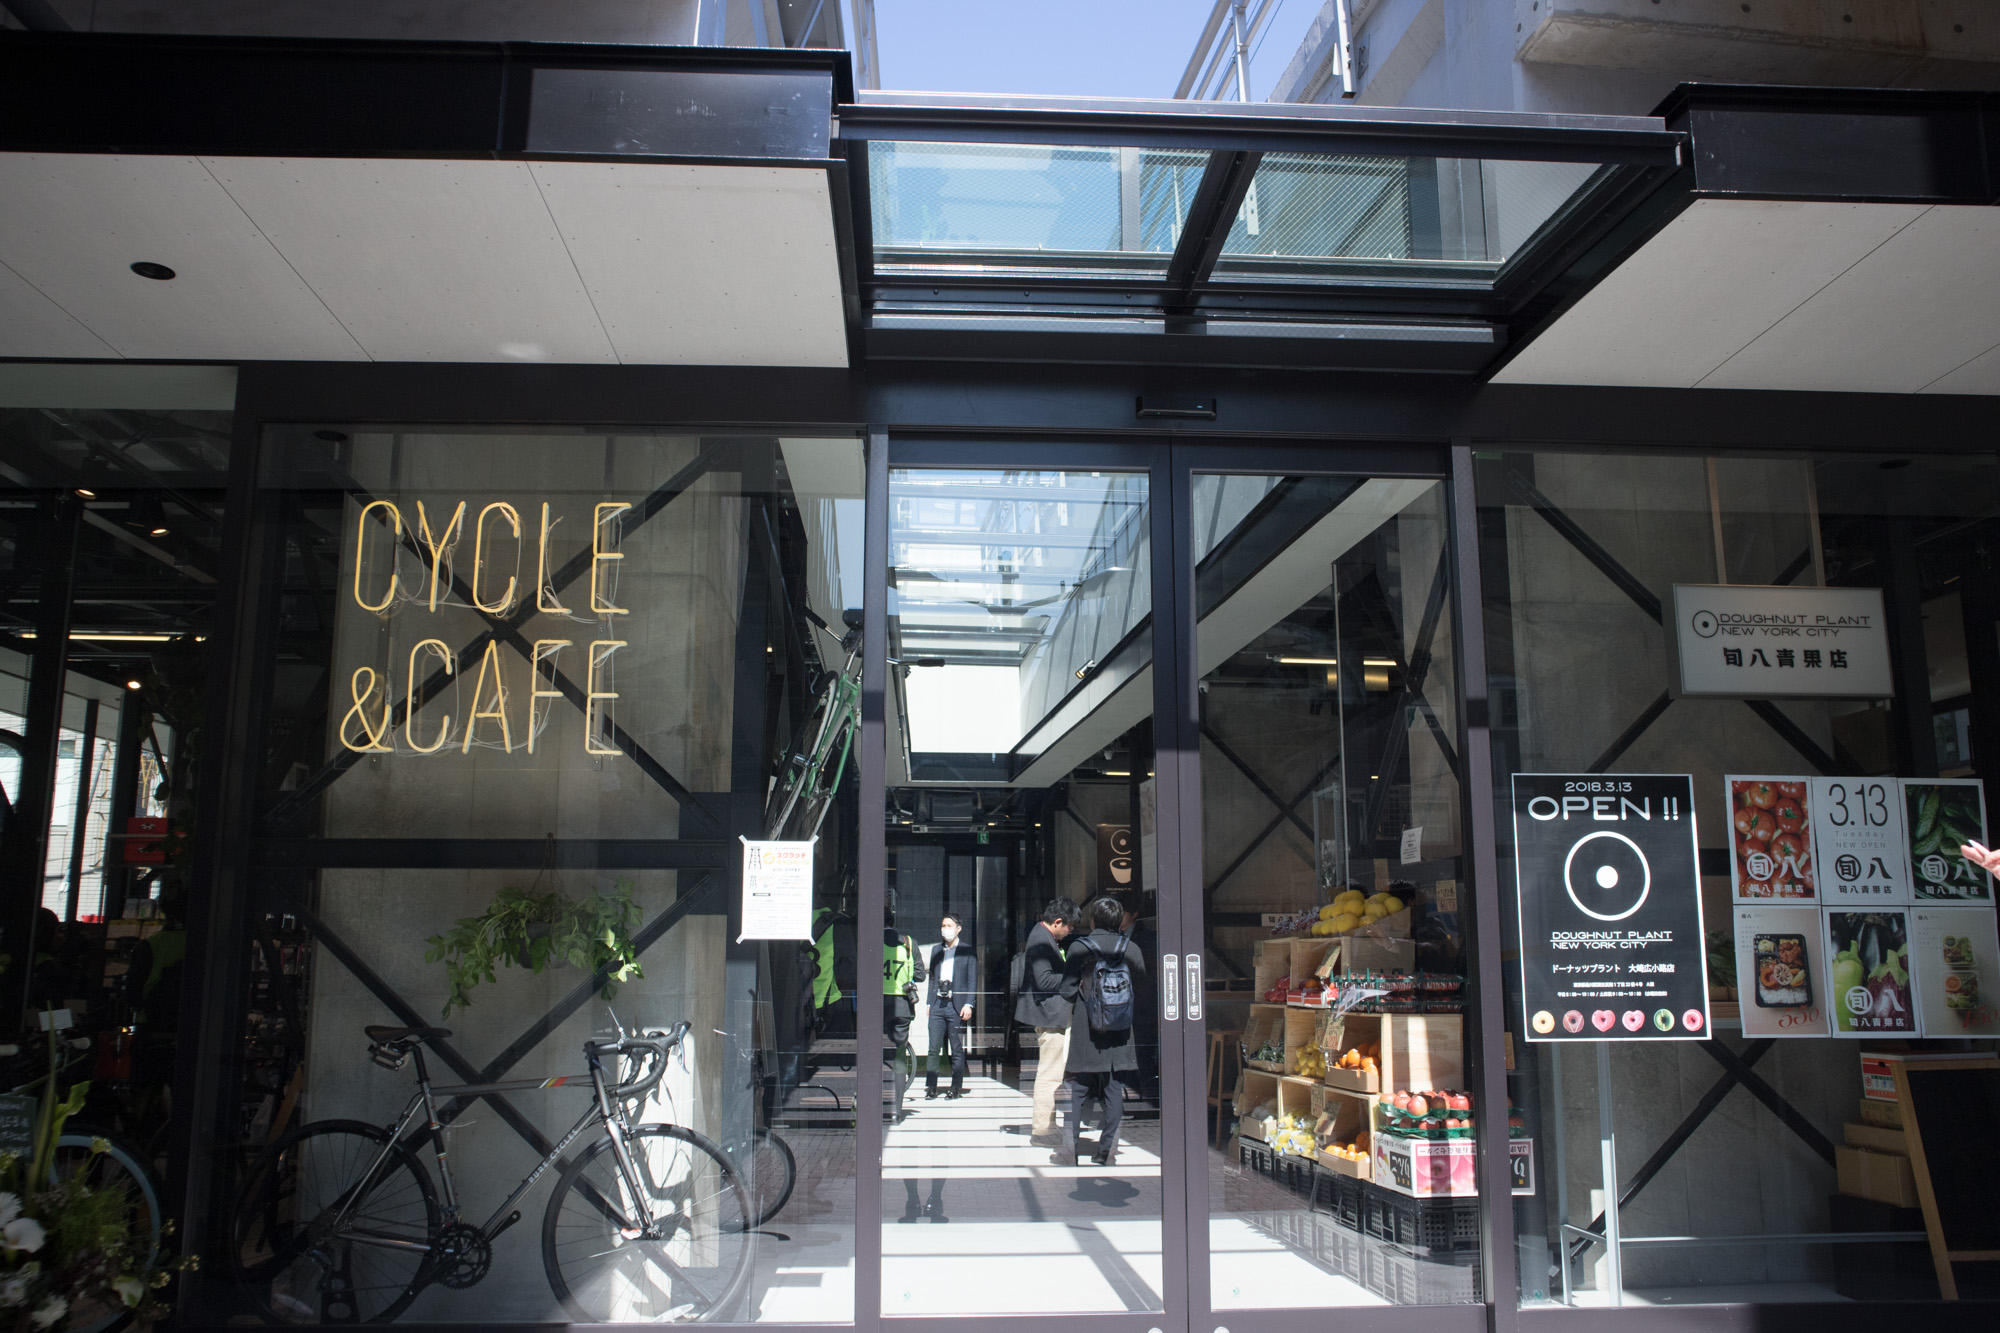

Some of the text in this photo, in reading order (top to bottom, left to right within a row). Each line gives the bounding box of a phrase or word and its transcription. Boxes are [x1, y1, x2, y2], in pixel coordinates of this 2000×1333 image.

[354, 499, 633, 614] CYCLE
[1720, 613, 1871, 626] DOUGHNUT PLANT
[1721, 627, 1840, 637] NEW YORK CITY
[1723, 647, 1848, 669] 旬八青果店
[1565, 781, 1632, 792] 2018.3.13
[1527, 796, 1651, 821] OPEN
[1829, 783, 1888, 827] 3.13
[1747, 853, 1804, 881] 旬八
[1835, 854, 1893, 882] 旬八
[1921, 855, 1980, 883] 旬八
[1750, 884, 1804, 894] 旬八青果店
[1839, 885, 1892, 894] 旬八青果店
[1925, 886, 1979, 895] 旬八青果店
[1552, 931, 1673, 940] DOUGHNUT PLANT
[884, 959, 905, 980] 47
[1552, 964, 1621, 974] ドーナッツプラント
[1845, 985, 1905, 1015] 旬八
[1849, 1017, 1904, 1027] 旬八青果店
[528, 1129, 578, 1183] PURE CYCLES
